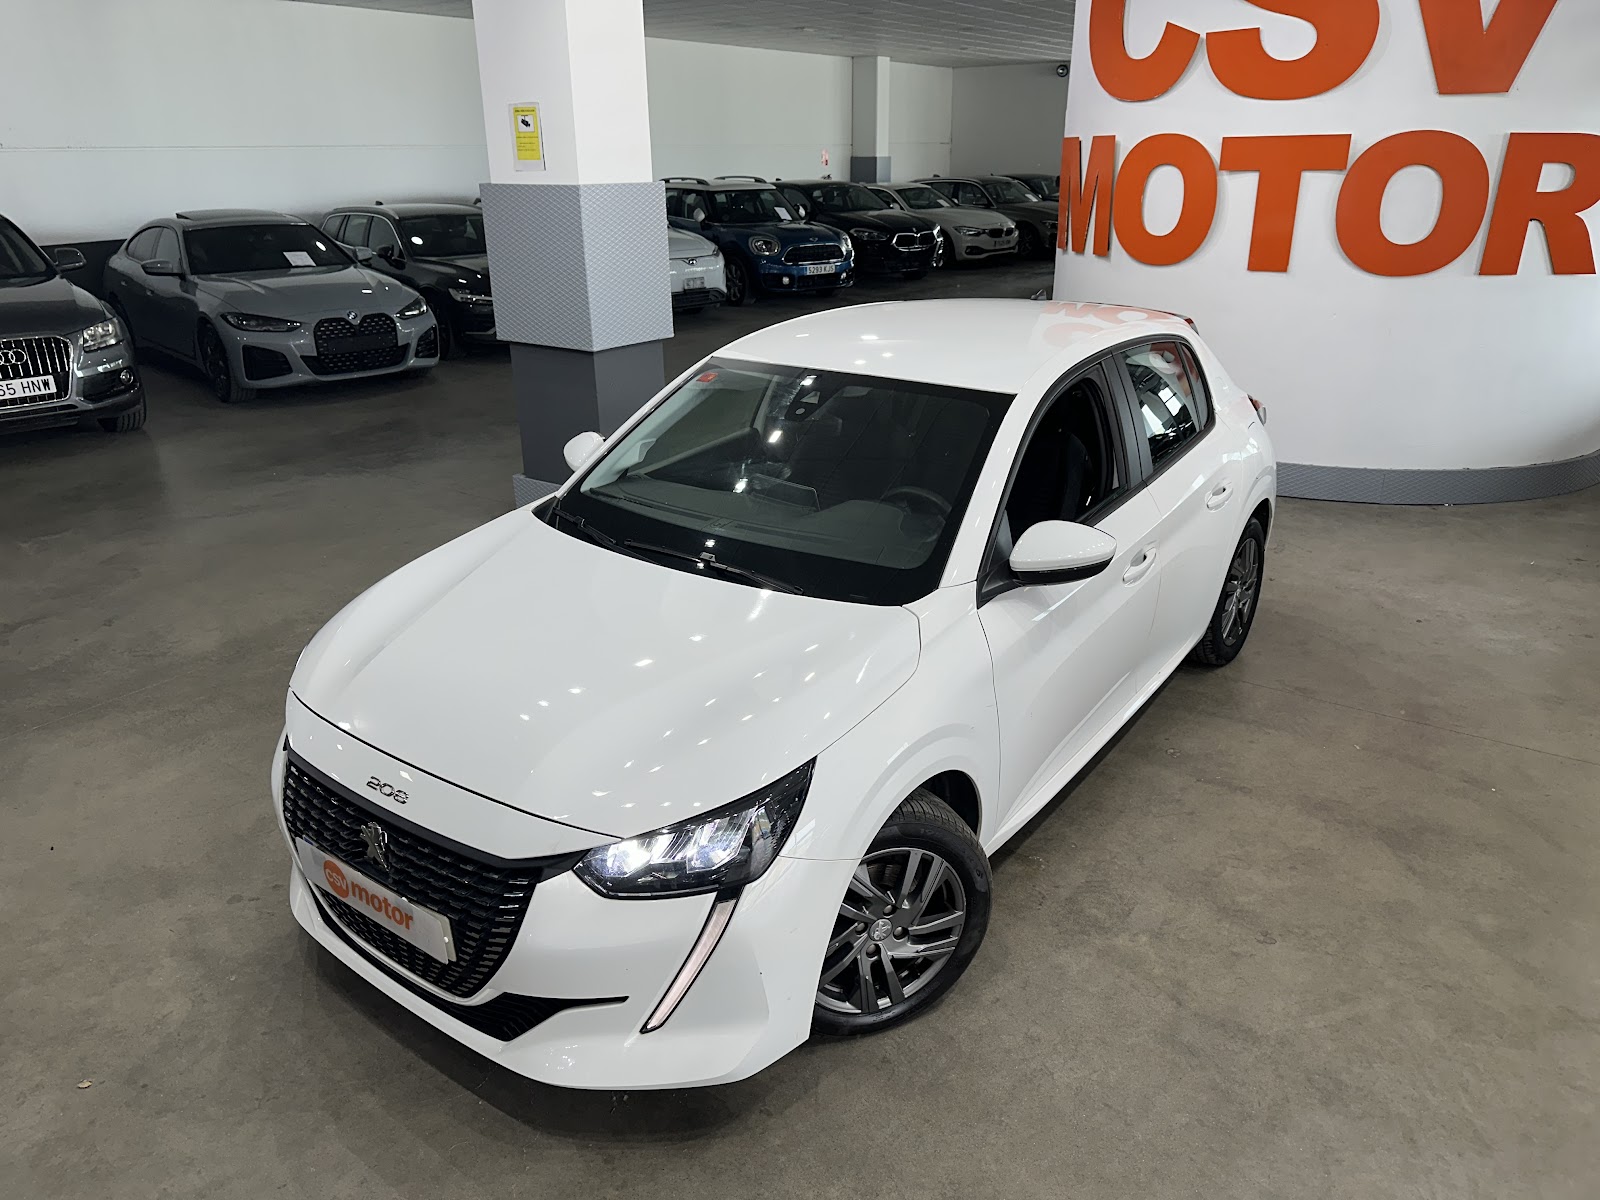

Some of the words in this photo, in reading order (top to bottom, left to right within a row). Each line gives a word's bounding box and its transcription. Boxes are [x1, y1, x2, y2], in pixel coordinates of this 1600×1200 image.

[1089, 0, 1557, 101] CSV
[1058, 130, 1600, 277] MOTOR
[21, 378, 51, 393] HNW
[366, 776, 409, 804] 208
[325, 868, 347, 890] CSV
[351, 881, 413, 930] motor
